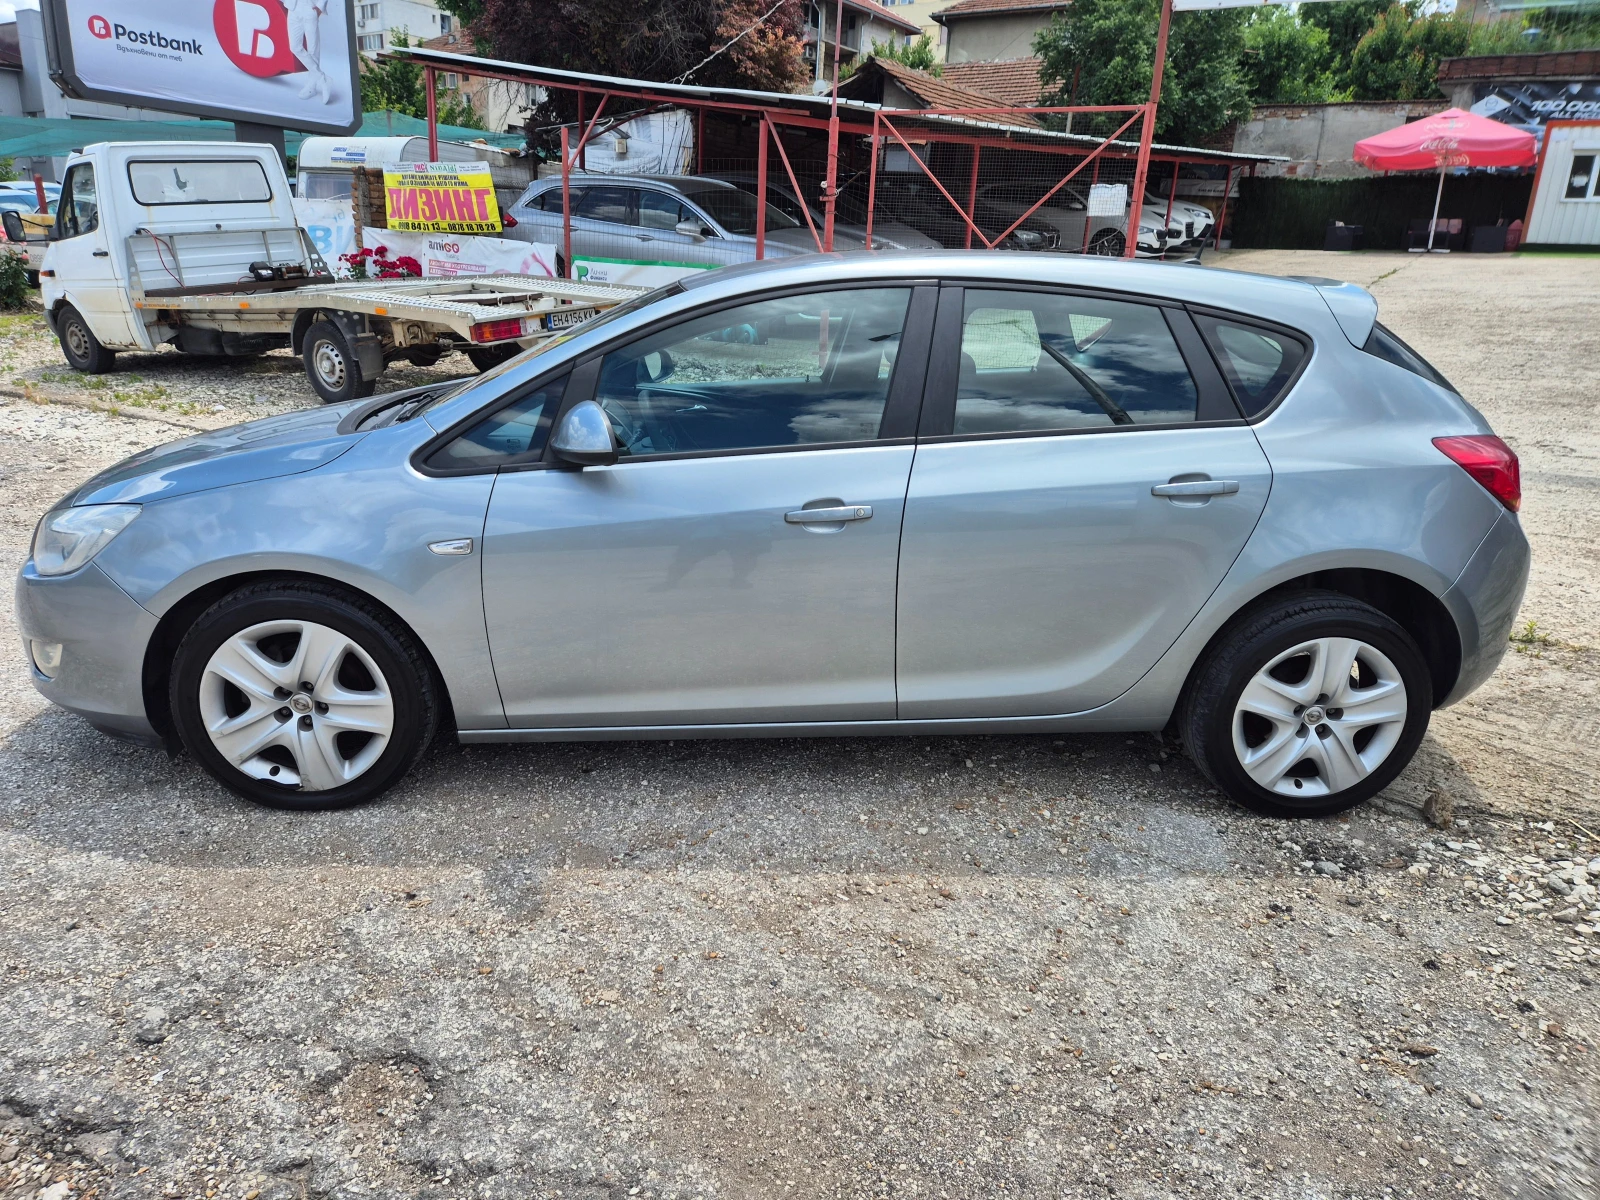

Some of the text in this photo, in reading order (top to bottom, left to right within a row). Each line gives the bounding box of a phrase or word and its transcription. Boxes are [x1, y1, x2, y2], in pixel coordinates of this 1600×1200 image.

[114, 23, 203, 55] Postbank
[116, 44, 157, 58] Вдъхновени
[169, 54, 183, 62] теб
[1531, 100, 1566, 111] 100
[388, 188, 490, 221] ЛИЗИНГ
[411, 222, 421, 232] 84
[431, 222, 440, 231] 13
[466, 223, 474, 231] 18
[476, 223, 484, 232] 78
[486, 223, 496, 232] 28
[552, 314, 564, 327] EH
[565, 312, 583, 324] 4156
